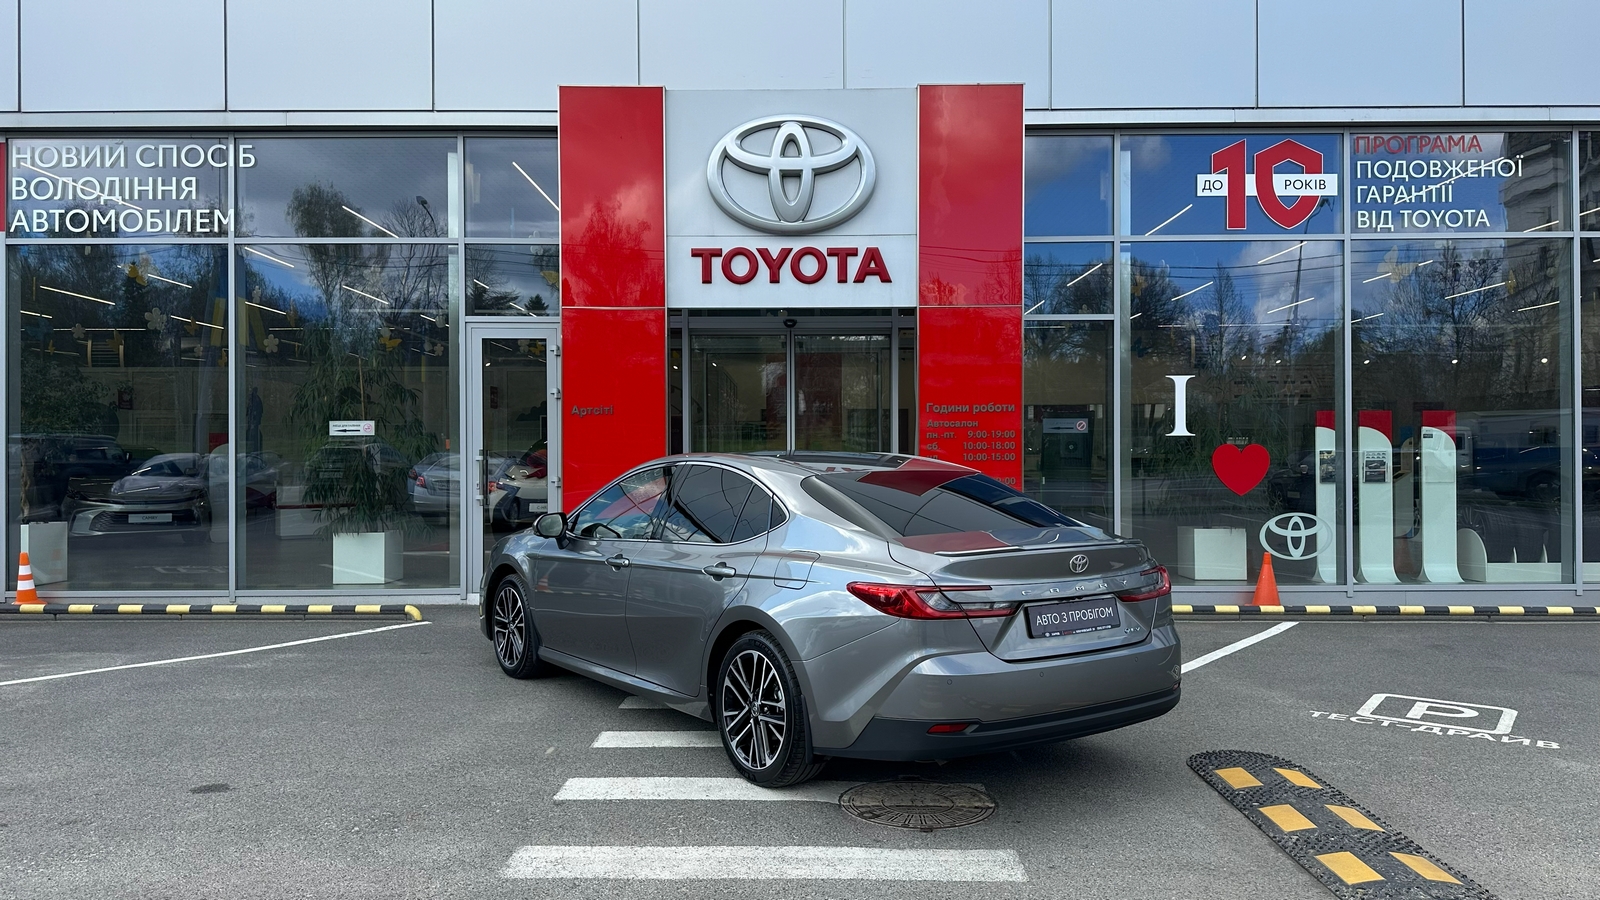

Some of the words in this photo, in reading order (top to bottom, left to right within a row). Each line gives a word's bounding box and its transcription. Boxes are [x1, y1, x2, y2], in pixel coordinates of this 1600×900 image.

[1355, 135, 1483, 154] ПРОГРАМА
[12, 141, 126, 168] НОВИЙ
[135, 144, 256, 168] СПОСІБ
[1356, 155, 1523, 182] ПОДОВЖЕНОЇ
[11, 176, 197, 205] ВОЛОДІННЯ
[1202, 179, 1223, 193] ДО
[1211, 138, 1323, 230] 10
[1284, 178, 1327, 191] РОКІВ
[1356, 181, 1455, 204] ГАРАНТІЇ
[9, 208, 235, 233] АВТОМОБІЛЕМ
[1357, 210, 1393, 232] ВІД
[1399, 209, 1491, 229] TOYOTA
[691, 246, 893, 285] TOYOTA
[571, 405, 613, 418] Артсіті
[926, 402, 969, 414] Години
[972, 402, 1015, 414] роботи
[1165, 375, 1196, 436] I
[926, 419, 979, 427] Автосалон
[967, 430, 1016, 438] 9:00-19:00
[962, 441, 1016, 450] 10:00-18:00
[962, 453, 1016, 461] 10:00-15:00
[1021, 580, 1128, 596] CAMRY
[1036, 613, 1060, 626] АВТО
[1069, 606, 1114, 622] ПРОБІГОМ
[1405, 701, 1479, 720] P
[1309, 710, 1561, 749] ТЕСТ-ДРАЙВ
